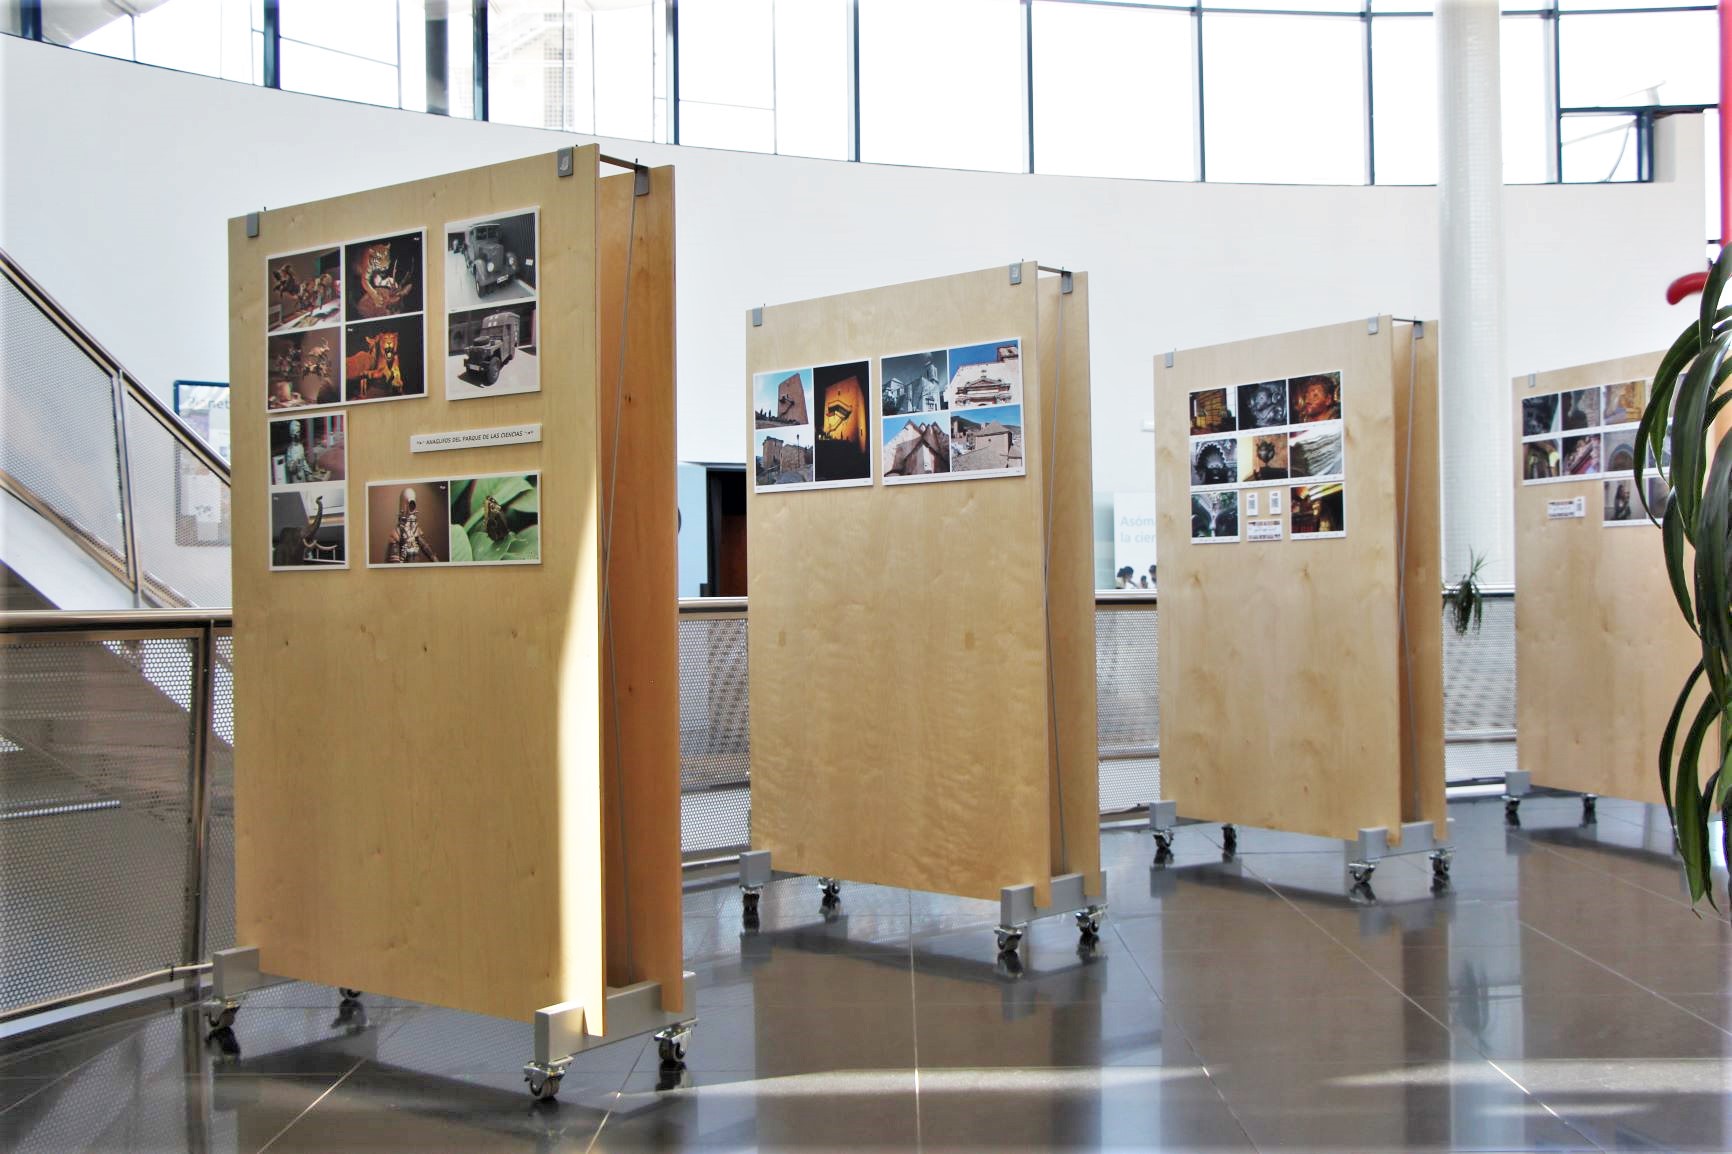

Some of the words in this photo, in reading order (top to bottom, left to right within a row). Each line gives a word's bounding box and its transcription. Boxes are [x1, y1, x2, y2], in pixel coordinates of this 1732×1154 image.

[501, 430, 523, 438] CIENCIAS
[1120, 515, 1154, 527] Asóm
[1120, 531, 1131, 543] la
